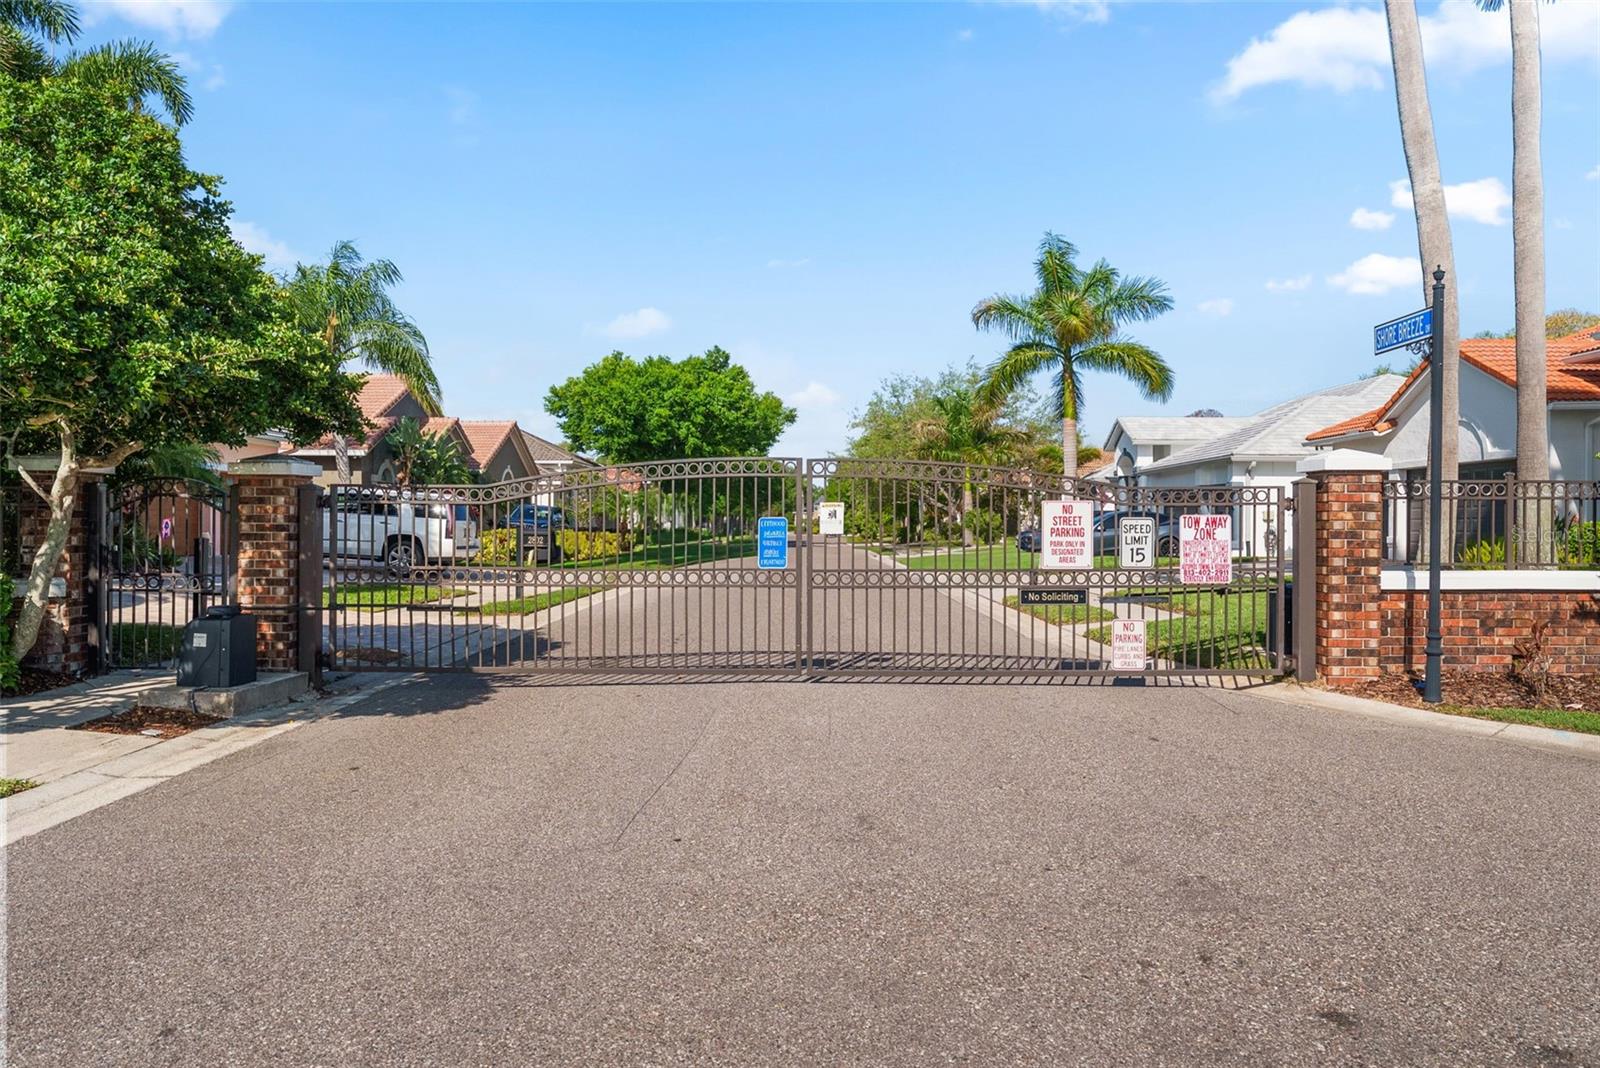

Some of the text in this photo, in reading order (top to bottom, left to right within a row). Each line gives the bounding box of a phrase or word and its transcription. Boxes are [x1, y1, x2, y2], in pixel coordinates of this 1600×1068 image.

[1376, 325, 1397, 349] SHORE
[1398, 315, 1424, 342] BREEZE
[1062, 504, 1073, 515] NO
[1052, 515, 1083, 526] STREET
[1183, 516, 1229, 529] TOW AWAY
[1050, 527, 1085, 538] PARKING
[1123, 524, 1152, 534] SPEED
[1193, 528, 1217, 541] ZONE
[1050, 540, 1085, 548] PARK ONLY IN
[1124, 535, 1149, 545] LIMIT
[1051, 548, 1084, 556] DESIGNATED
[1129, 547, 1146, 563] 15
[1058, 556, 1076, 564] AREAS
[1028, 592, 1079, 603] No Soliciting
[1123, 622, 1135, 632] NO
[1115, 633, 1143, 644] PARKING
